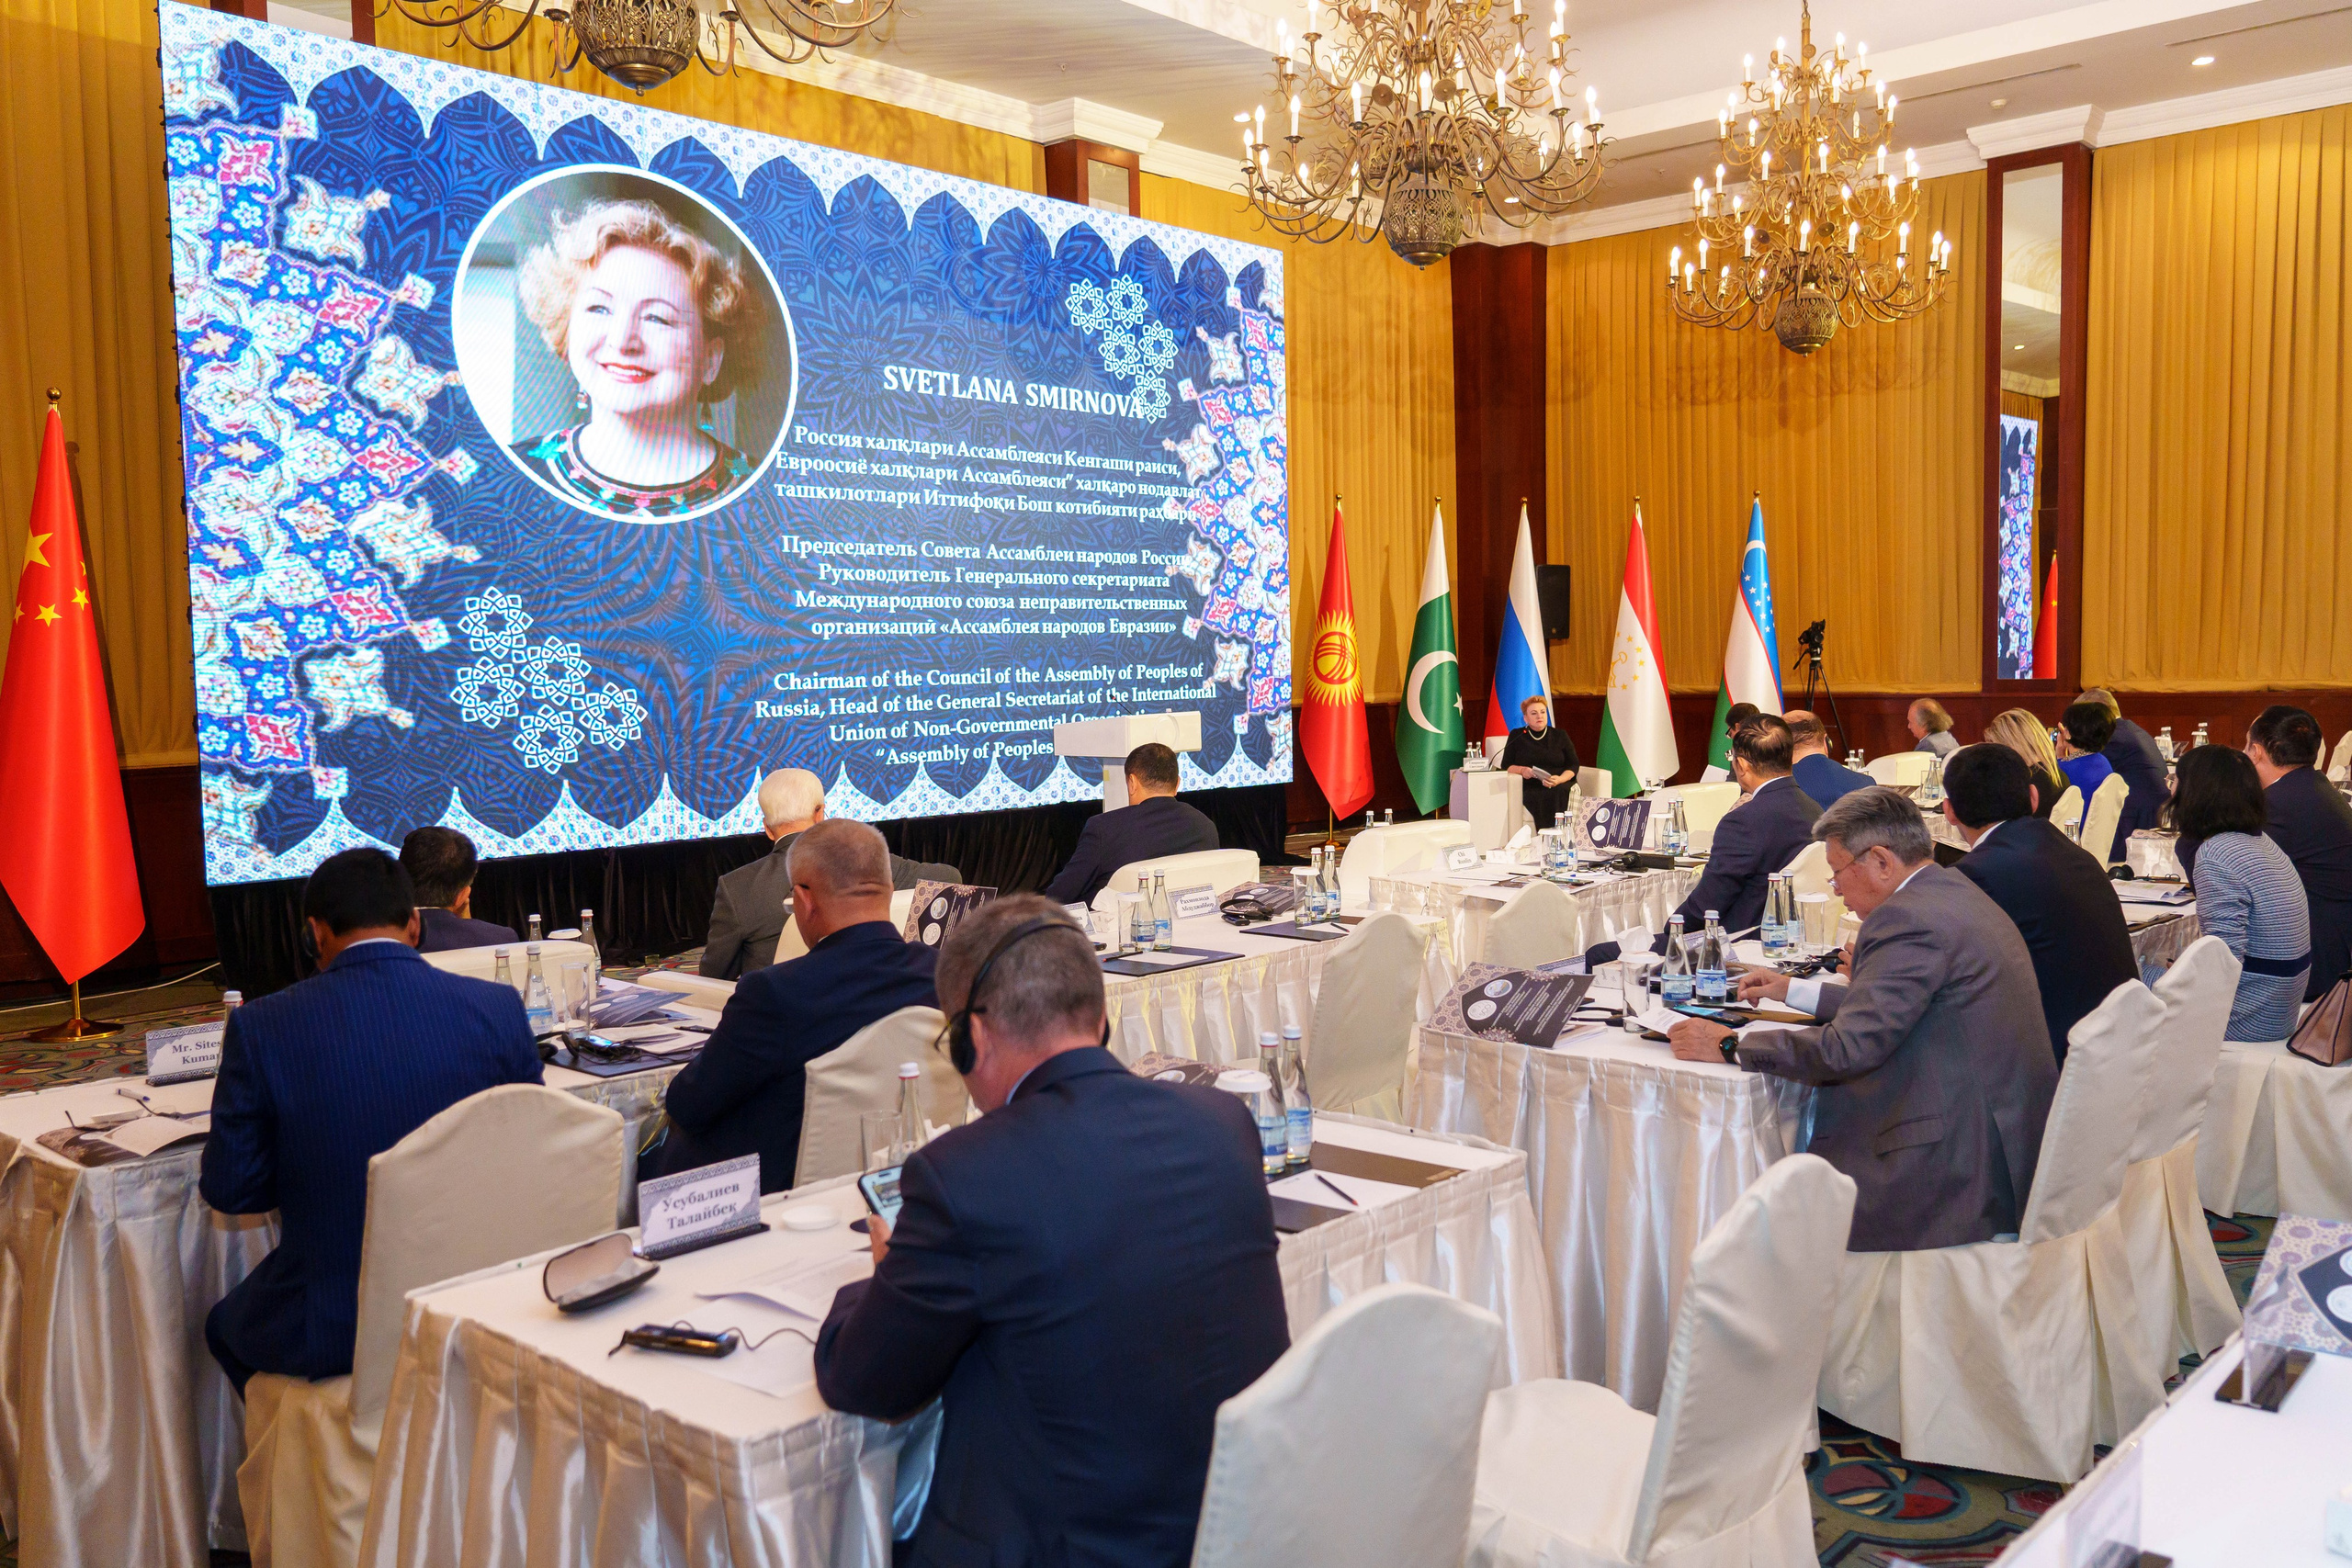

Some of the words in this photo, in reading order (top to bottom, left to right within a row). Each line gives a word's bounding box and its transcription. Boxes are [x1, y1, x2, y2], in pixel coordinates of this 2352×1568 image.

[883, 365, 1019, 405] SVETLANA
[1025, 383, 1145, 419] SMIRNOVA
[794, 425, 863, 448] Россия
[865, 436, 954, 461] халқлари
[956, 441, 1063, 467] Ассамблеяси
[1064, 450, 1134, 472] Кенгаши
[1136, 459, 1182, 479] раиси,
[870, 461, 958, 486] халқлари
[1076, 478, 1136, 498] халқаро
[775, 482, 922, 509] ташкилотлари
[922, 488, 1016, 513] Иттифоқи
[1017, 494, 1053, 513] Бош
[1056, 500, 1138, 518] котибияти
[782, 535, 918, 558] Председатель
[921, 540, 981, 559] Совета
[986, 544, 1074, 562] Ассамблеи
[1077, 552, 1138, 568] народов
[819, 562, 951, 585] Руководитель
[955, 567, 1069, 588] Генерального
[1071, 574, 1170, 592] секретариата
[795, 590, 962, 613] Международного
[966, 595, 1015, 609] союза
[1019, 596, 1188, 614] неправительственных
[811, 618, 936, 639] организаций
[940, 617, 1039, 635] «Ассамблея
[1042, 621, 1106, 637] народов
[1109, 617, 1177, 637] Евразии»
[774, 671, 867, 691] Chairman
[871, 670, 890, 688] of
[895, 669, 922, 687] the
[926, 668, 991, 686] Council
[995, 668, 1012, 684] of
[1015, 667, 1040, 683] the
[1044, 665, 1116, 685] Assembly
[1118, 663, 1134, 680] of
[1136, 662, 1188, 682] Peoples
[1190, 661, 1204, 678] of
[754, 700, 826, 719] Russia,
[829, 696, 878, 716] Head
[882, 695, 901, 714] of
[905, 694, 933, 712] the
[936, 692, 1001, 711] General
[1005, 689, 1085, 708] Secretariat
[1088, 688, 1103, 705] of
[1106, 687, 1129, 704] the
[1132, 683, 1216, 703] International
[829, 723, 888, 742] Union
[890, 721, 909, 739] of
[913, 713, 1067, 738] Non-Governmental
[973, 741, 989, 760] of
[995, 739, 1054, 761] Peoples
[172, 1043, 193, 1055] Mr.
[662, 1182, 740, 1213] Усубалиев
